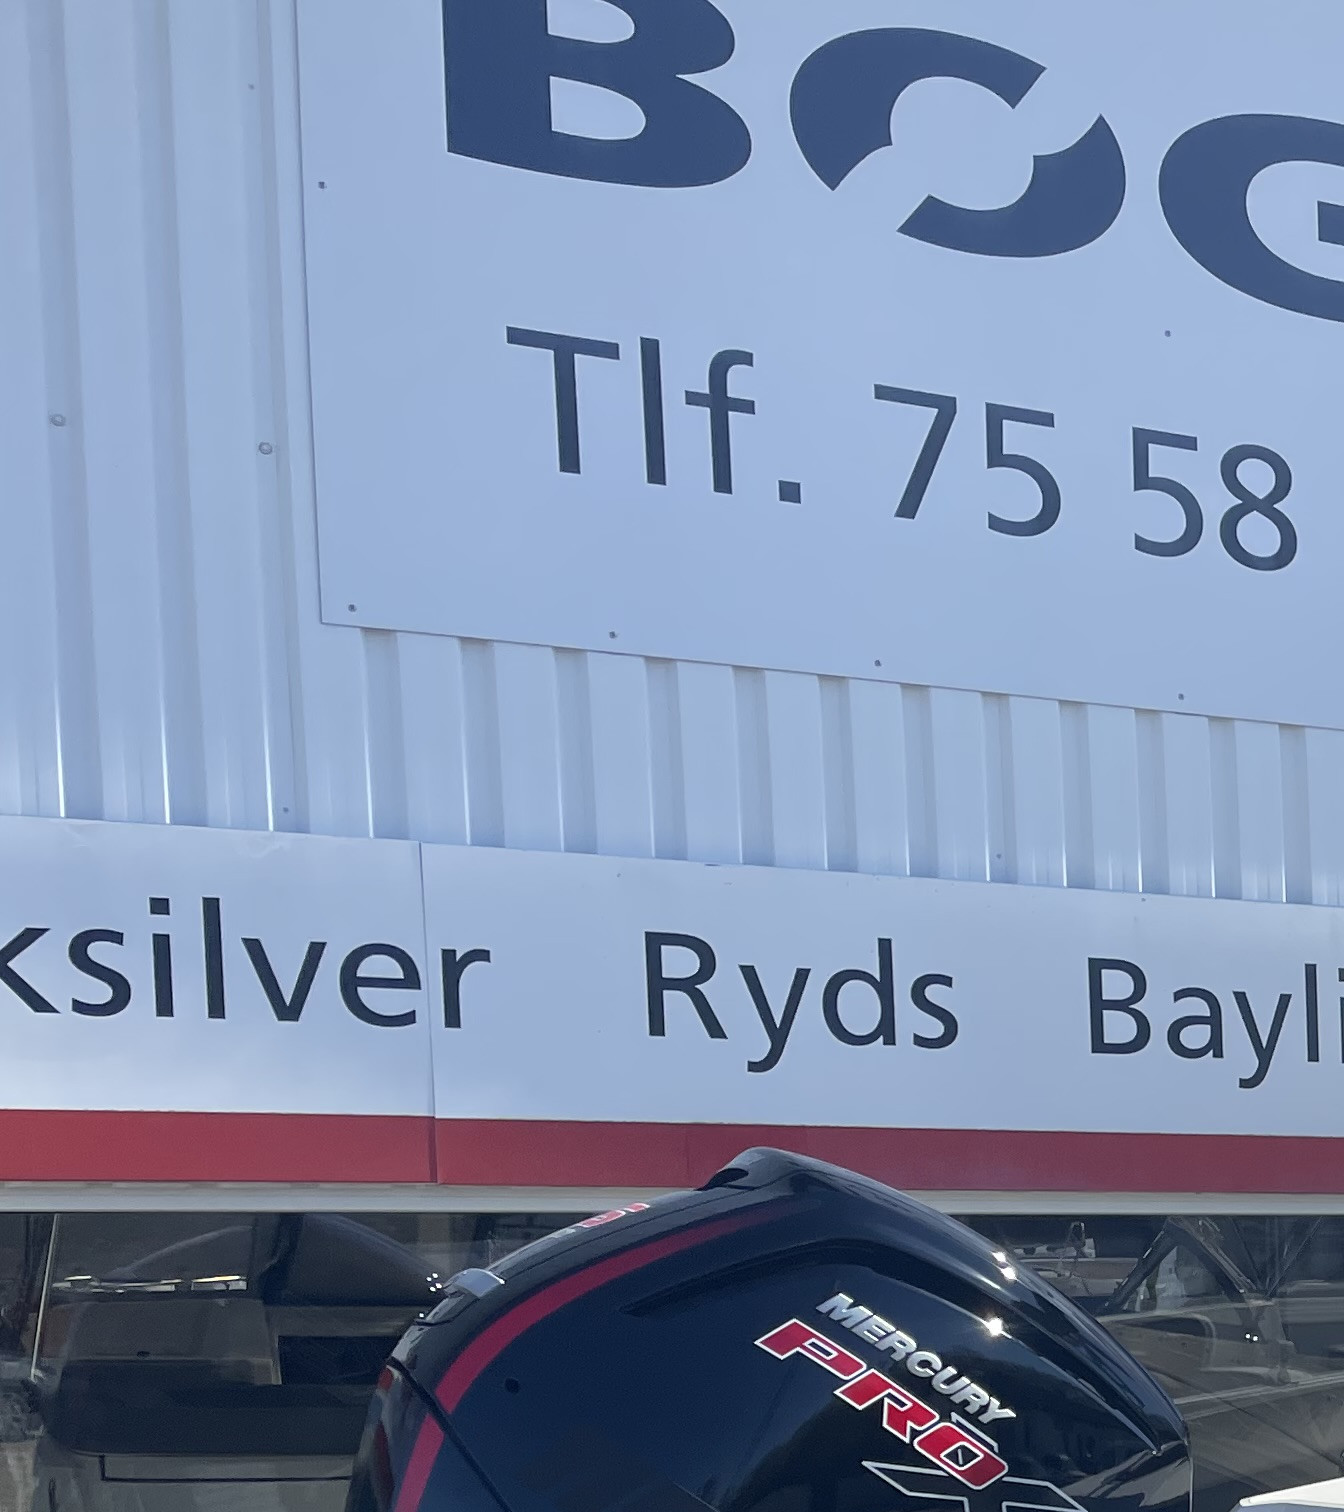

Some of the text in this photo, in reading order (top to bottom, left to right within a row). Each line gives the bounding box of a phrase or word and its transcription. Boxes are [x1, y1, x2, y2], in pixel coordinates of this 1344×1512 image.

[506, 325, 801, 504] Tlf.
[873, 383, 1062, 537] 75
[1131, 426, 1298, 572] 58
[644, 931, 959, 1073] Ryds
[754, 1318, 1009, 1490] PRO
[815, 1293, 1017, 1425] MERCURY
